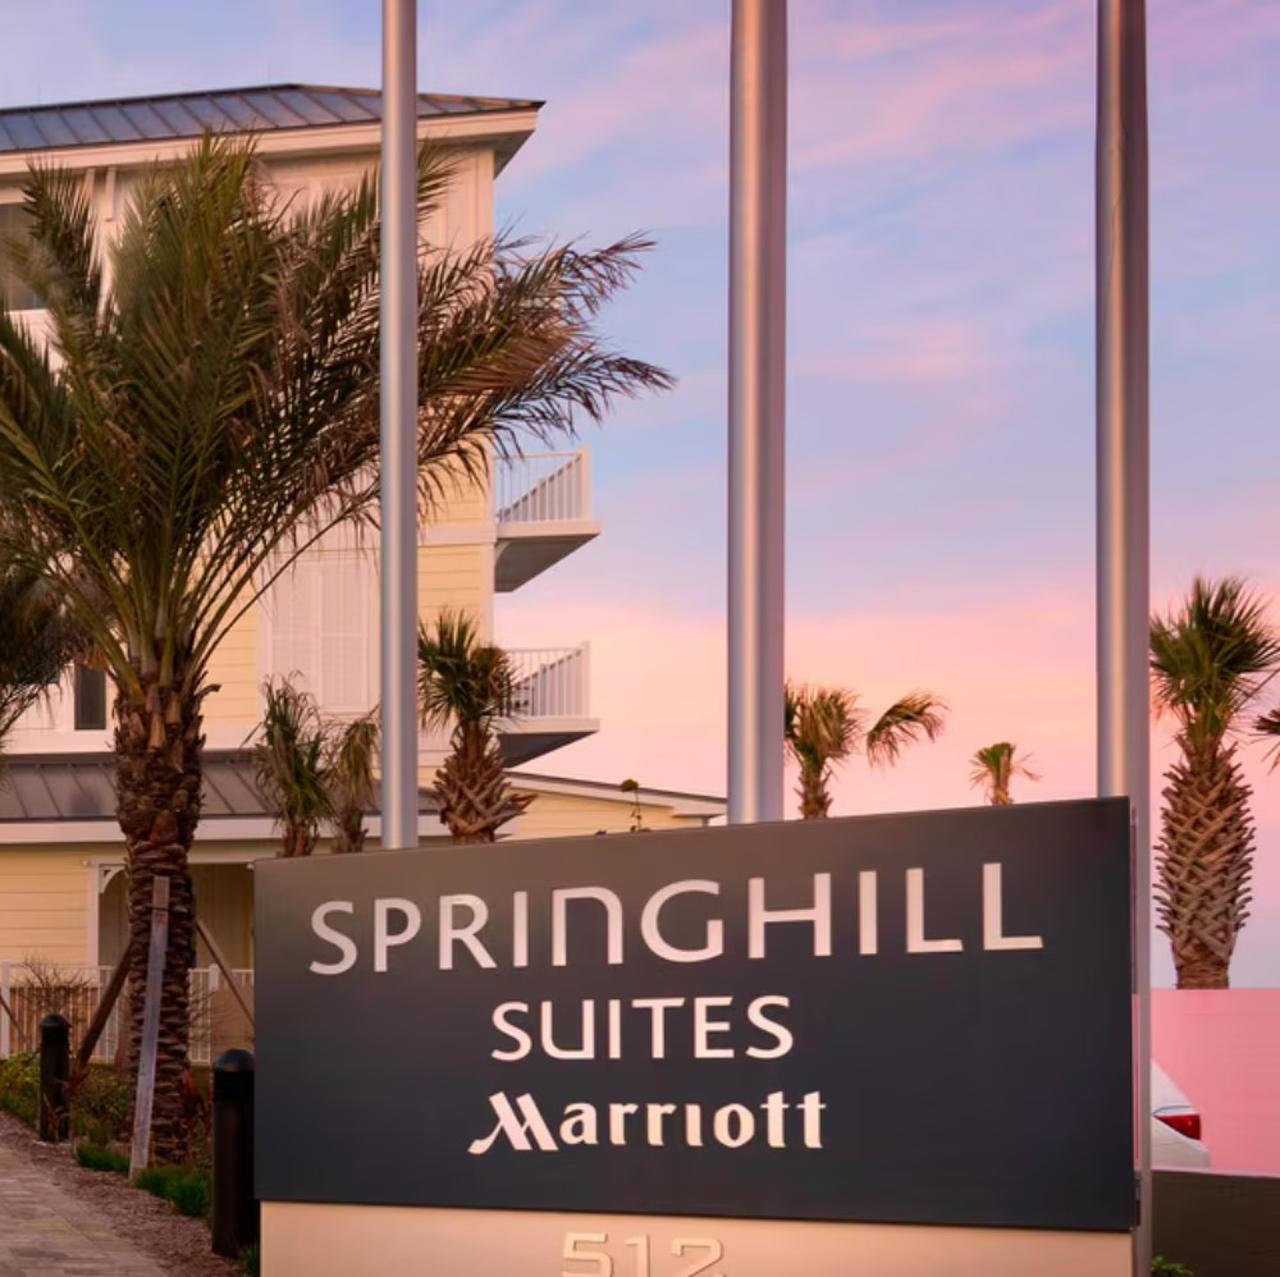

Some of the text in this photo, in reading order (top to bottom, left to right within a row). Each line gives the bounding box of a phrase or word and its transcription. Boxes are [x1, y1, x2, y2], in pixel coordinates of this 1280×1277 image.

[308, 862, 1045, 976] SPRINGHILL
[490, 995, 795, 1063] SUITES
[467, 1090, 827, 1155] Marriott
[560, 1231, 728, 1277] 512
